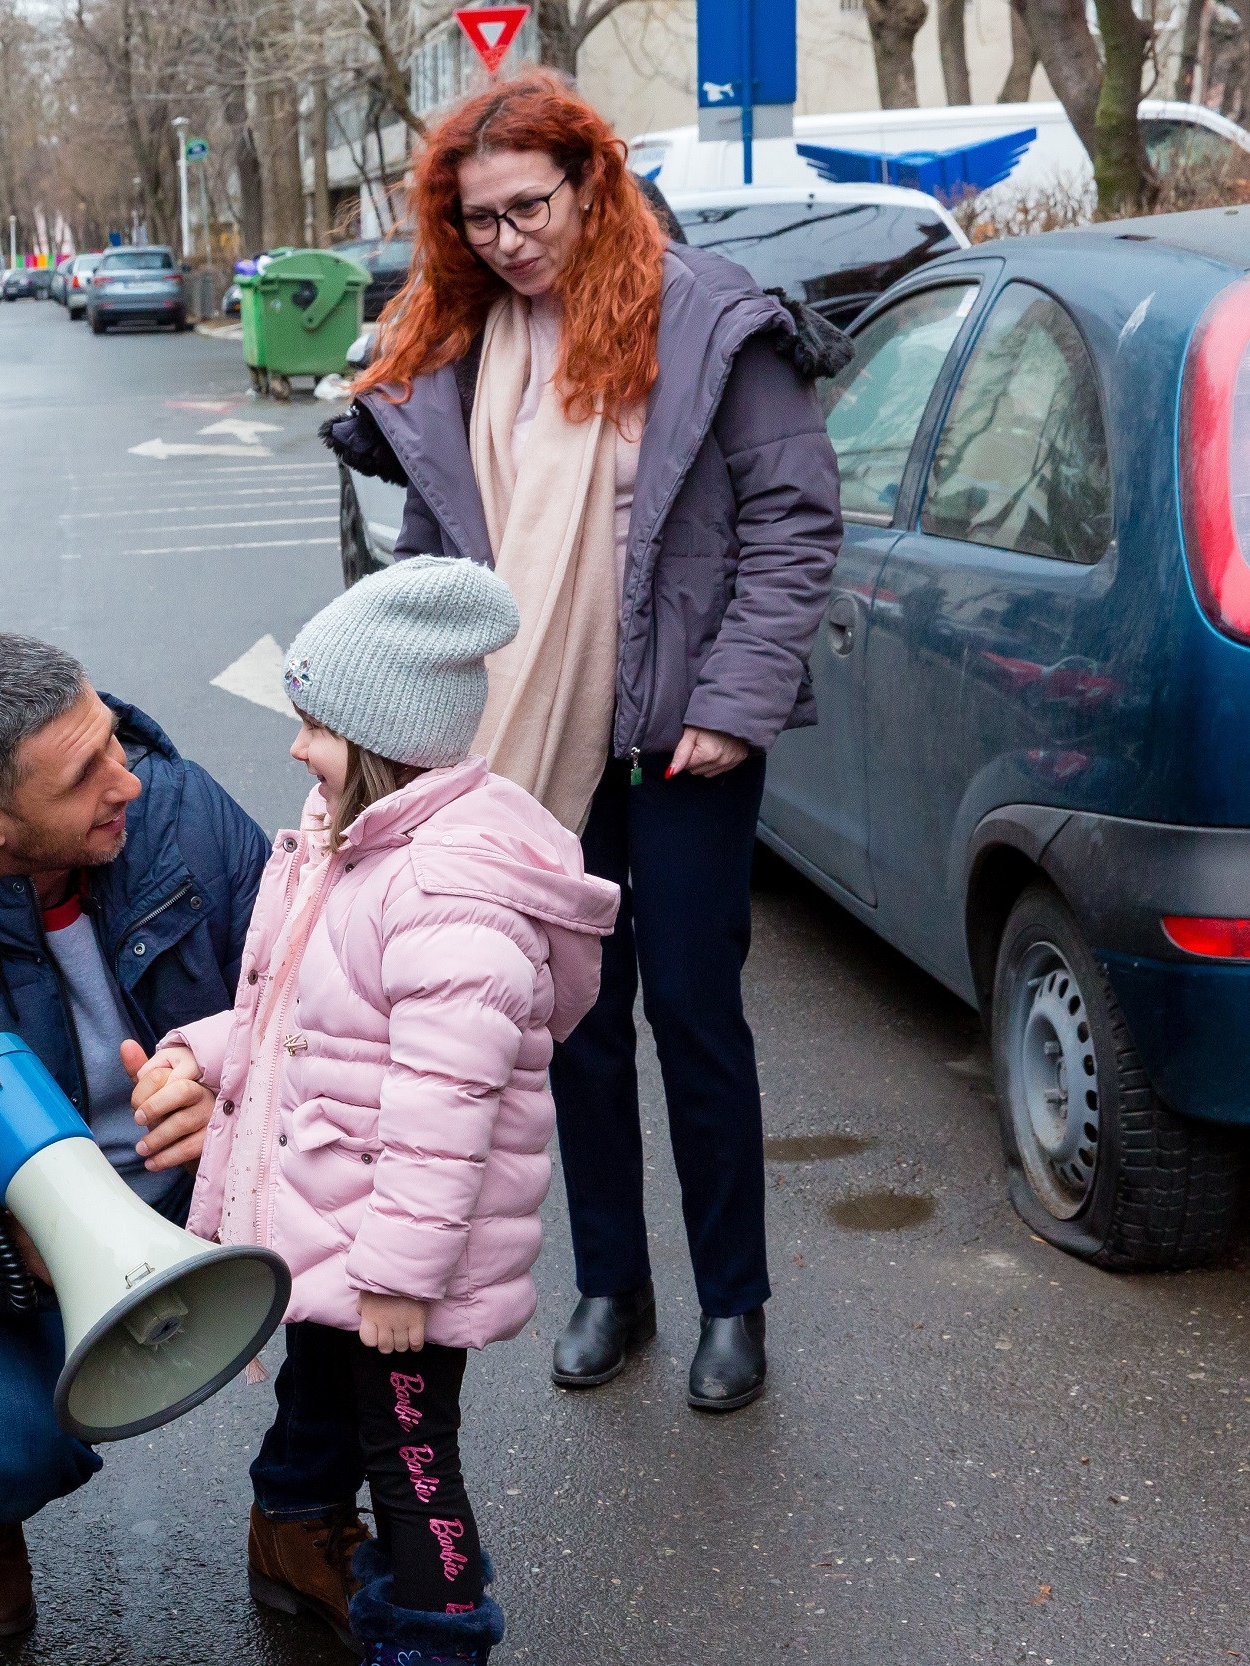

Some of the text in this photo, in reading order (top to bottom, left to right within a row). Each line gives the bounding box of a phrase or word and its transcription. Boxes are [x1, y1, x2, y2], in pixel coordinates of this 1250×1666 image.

[389, 1371, 425, 1433] Barbie
[398, 1443, 440, 1504] Barbie
[428, 1518, 469, 1582] Barbie
